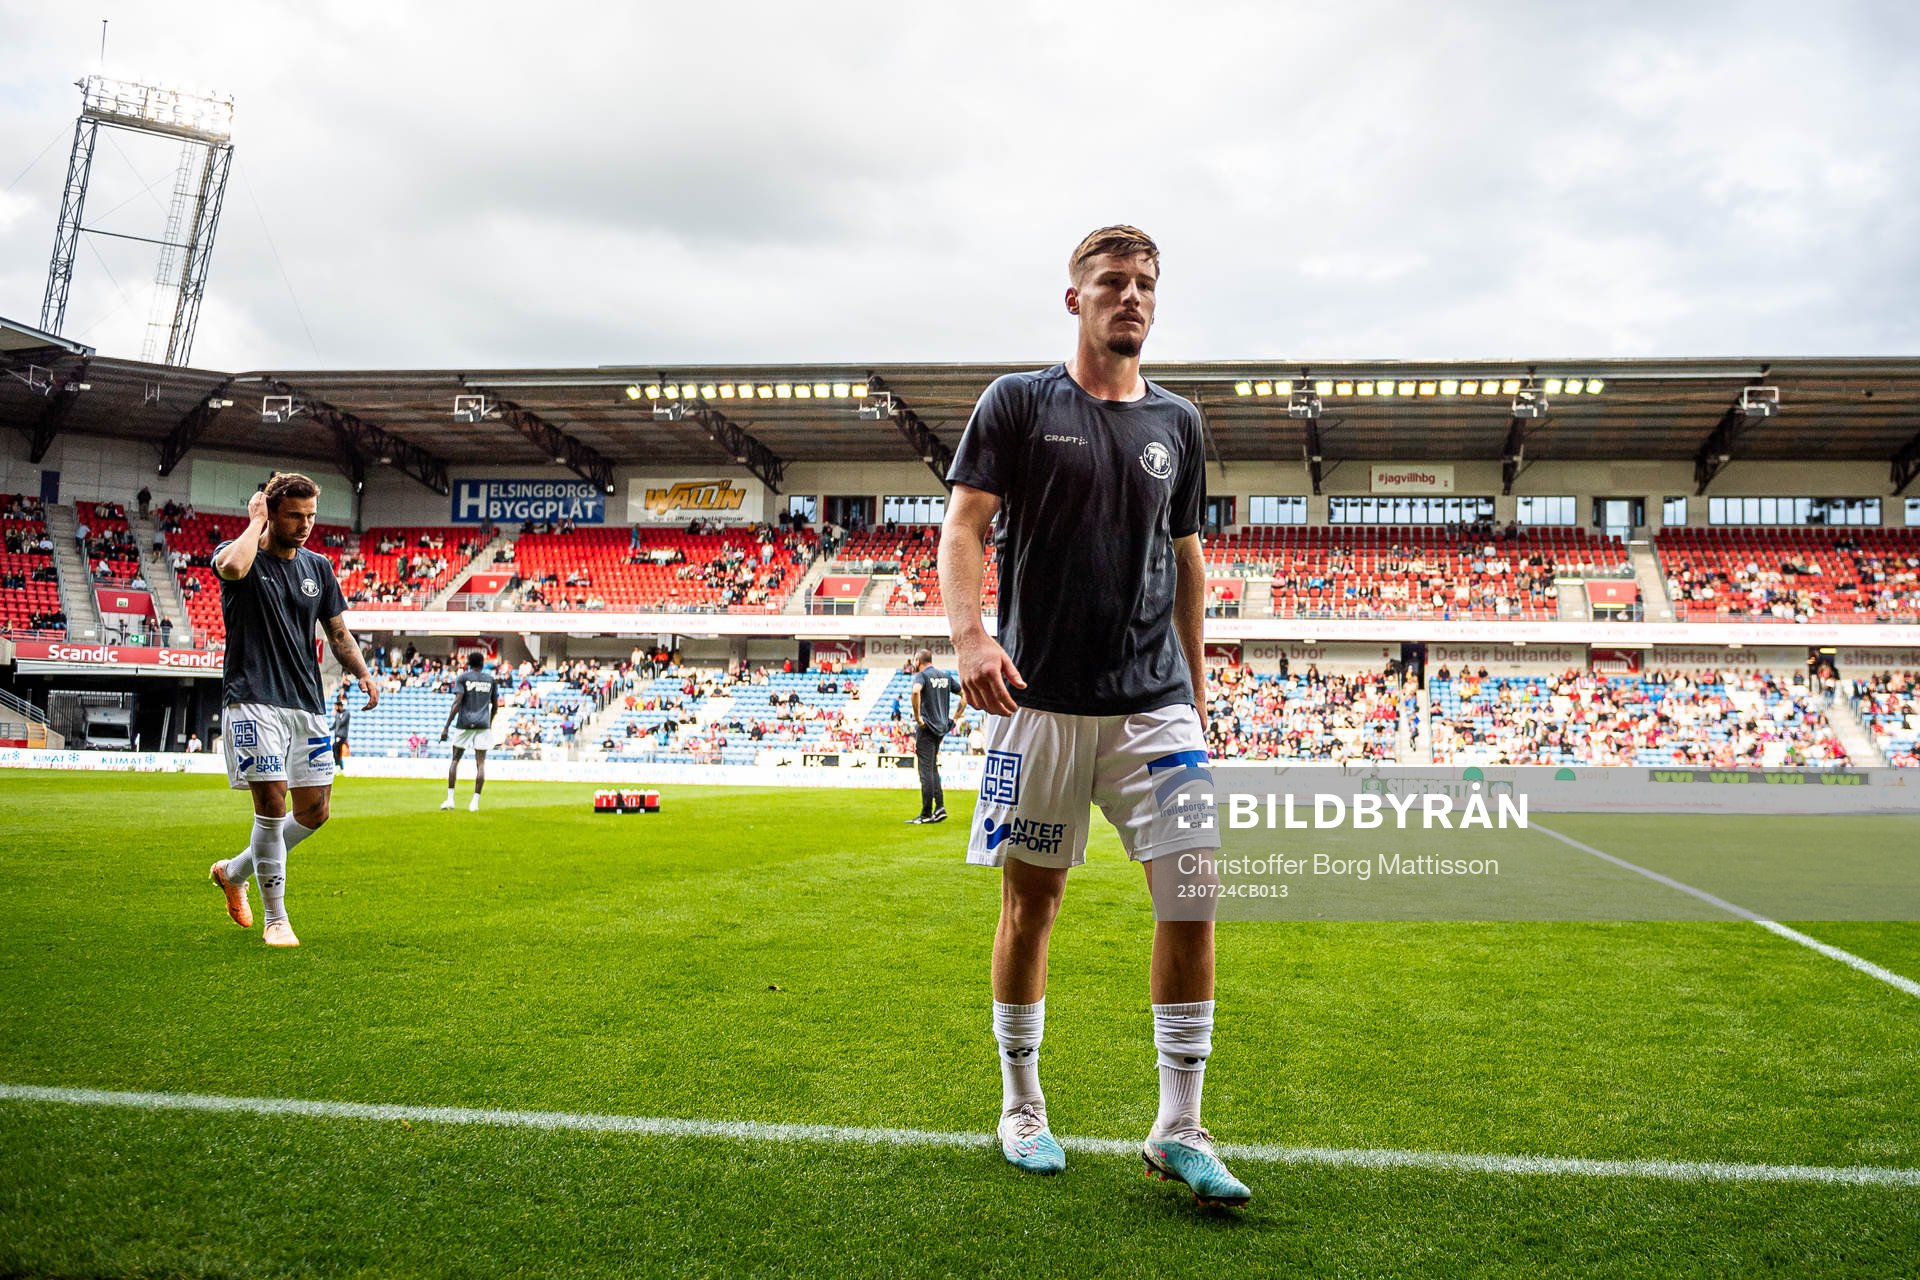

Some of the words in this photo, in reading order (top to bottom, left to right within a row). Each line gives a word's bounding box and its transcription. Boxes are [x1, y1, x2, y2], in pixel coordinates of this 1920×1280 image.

[1044, 435, 1078, 443] CRAFT
[1378, 472, 1436, 485] #jagvillhbg
[644, 480, 746, 515] WALLIN
[489, 497, 597, 519] BYGGPLÅT
[48, 645, 119, 662] Scandic
[871, 640, 898, 654] Det
[904, 640, 921, 654] är
[1253, 644, 1283, 659] och
[1290, 643, 1327, 659] bror
[1436, 647, 1466, 661] Det
[1470, 647, 1489, 662] är
[1493, 647, 1573, 663] bultande
[158, 650, 224, 668] Scandic
[1653, 650, 1719, 668] hjärtan
[1726, 650, 1758, 665] och
[1843, 650, 1892, 666] slitna
[256, 755, 282, 764] INTE
[256, 763, 283, 773] SPOR
